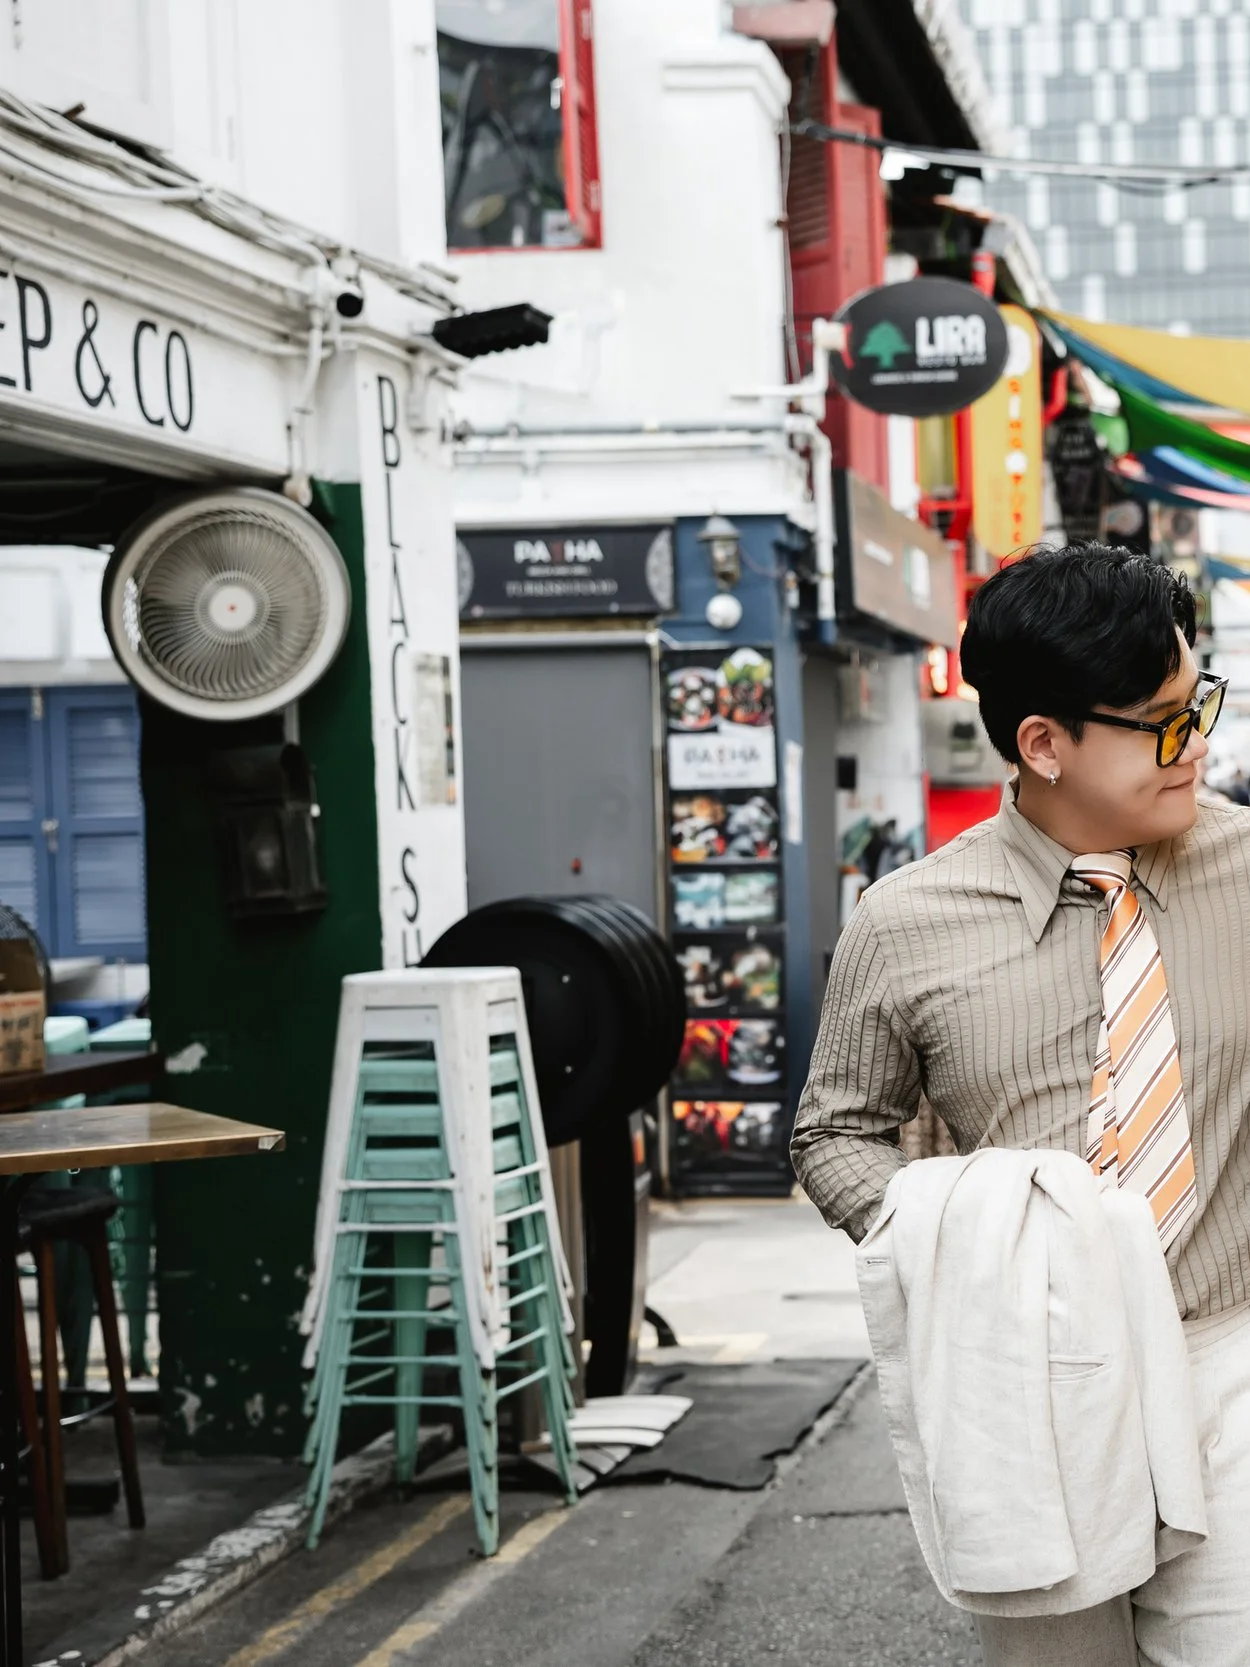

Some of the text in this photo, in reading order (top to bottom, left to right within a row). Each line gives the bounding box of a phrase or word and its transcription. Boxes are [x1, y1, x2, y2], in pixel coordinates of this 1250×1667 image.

[75, 299, 115, 408] &
[134, 320, 193, 432] CO
[915, 315, 987, 357] LIRA
[377, 375, 415, 811] BLACK
